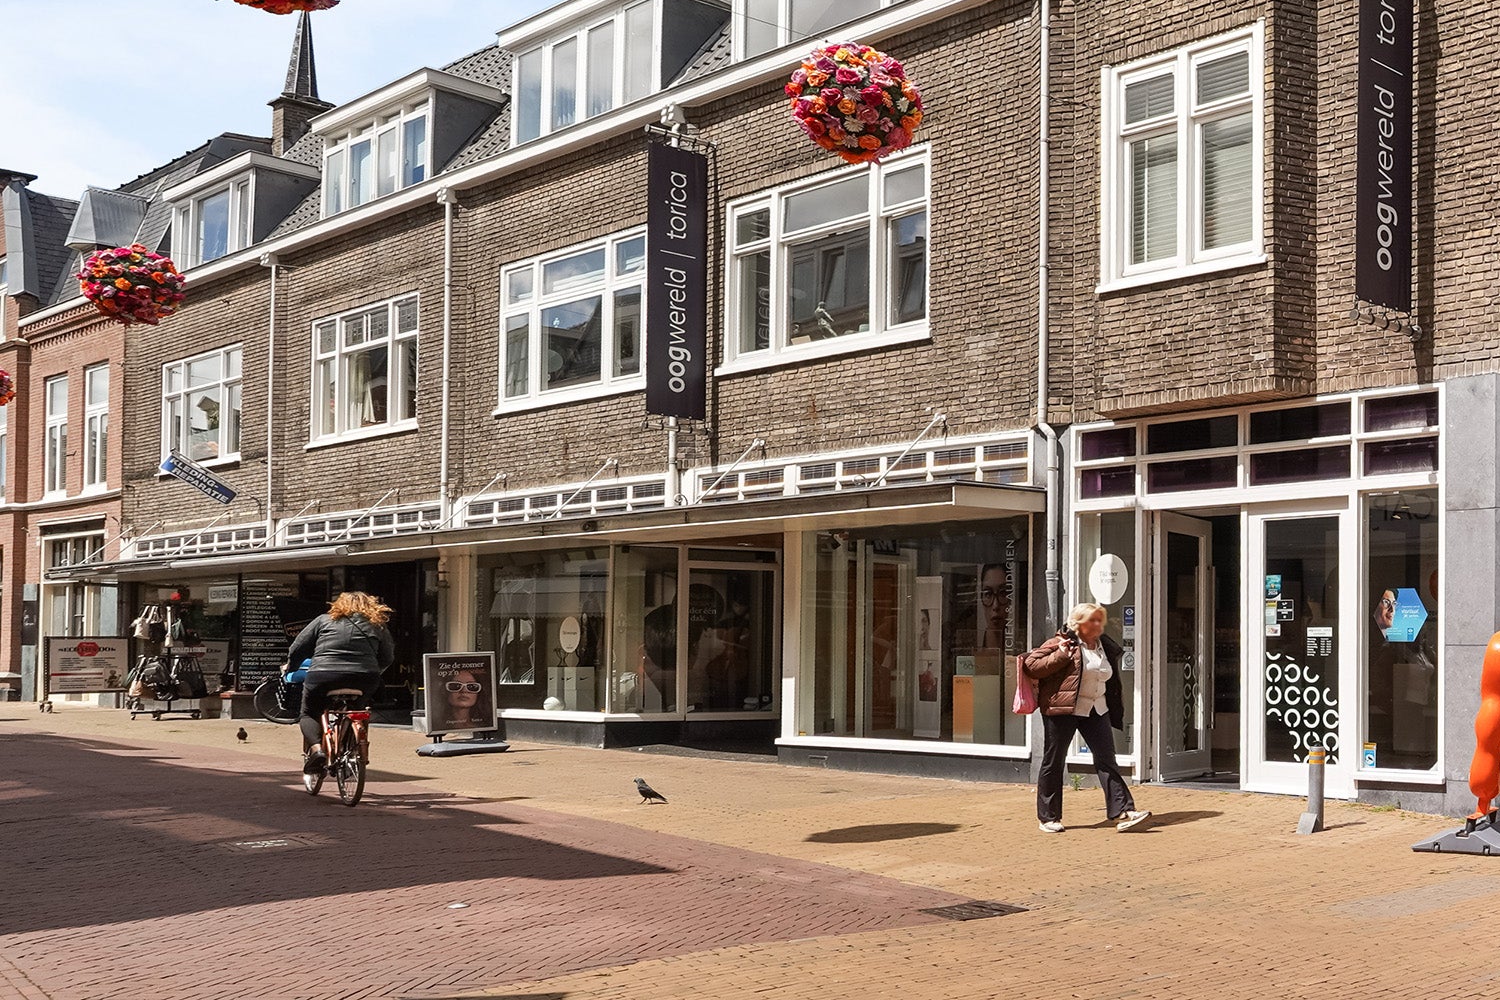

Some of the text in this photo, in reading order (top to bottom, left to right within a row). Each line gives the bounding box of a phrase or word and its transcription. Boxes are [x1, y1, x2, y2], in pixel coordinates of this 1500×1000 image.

[1374, 84, 1399, 271] oogwereld
[664, 171, 692, 393] oogwereld torica
[169, 457, 219, 489] KLEDING-
[171, 467, 230, 503] REPARATIE
